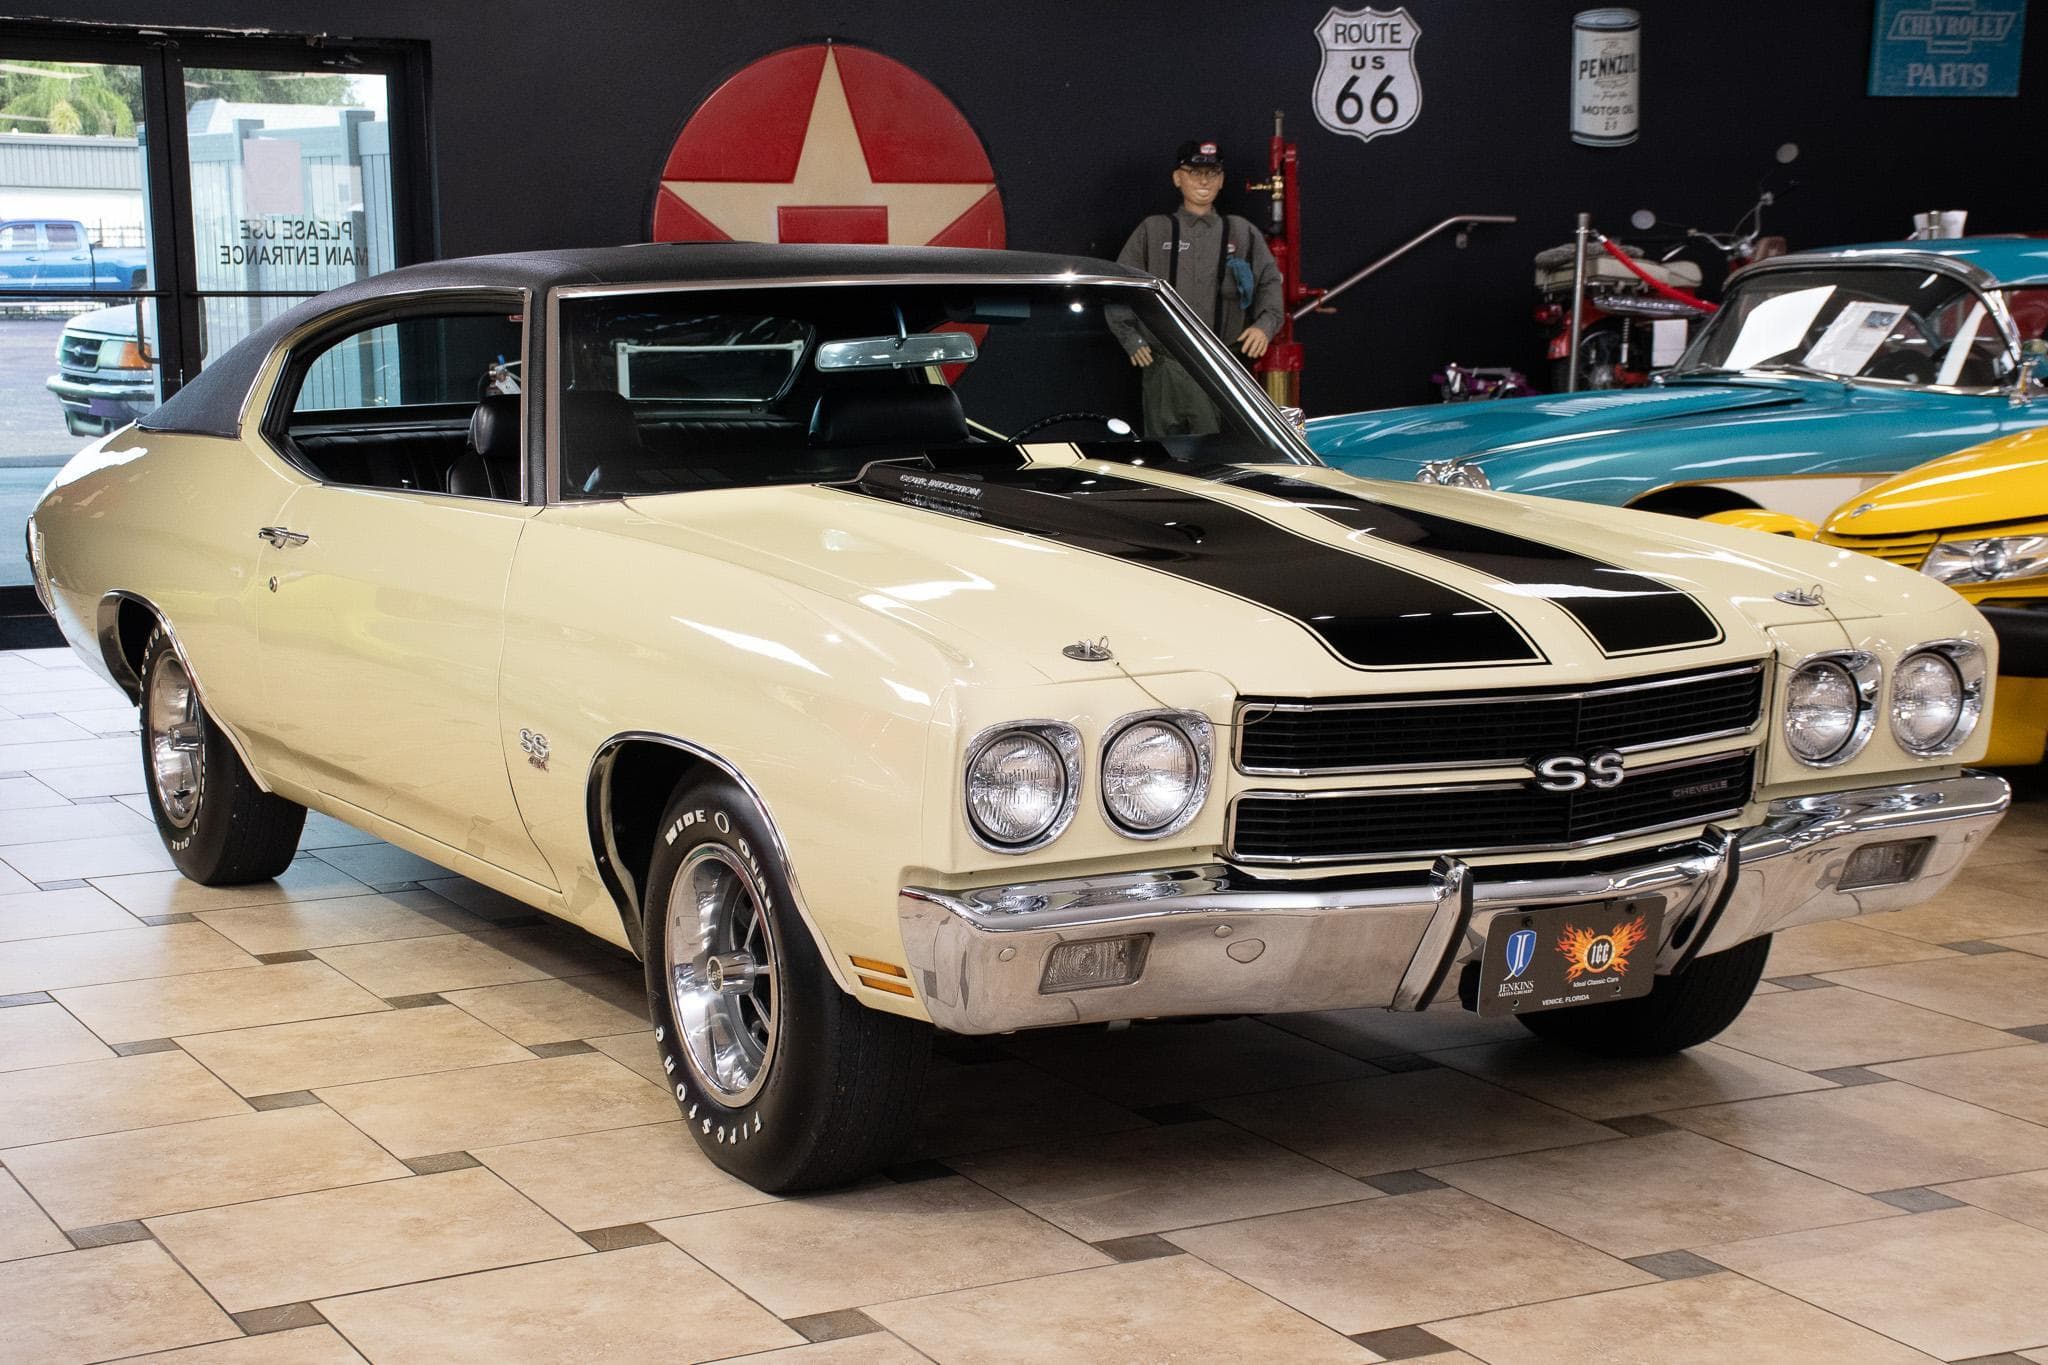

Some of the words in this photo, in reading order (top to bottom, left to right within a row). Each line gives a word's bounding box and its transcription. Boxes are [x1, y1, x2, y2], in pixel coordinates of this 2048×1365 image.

[1334, 23, 1402, 44] ROUTE
[1898, 15, 2006, 36] CHEVROLET
[1351, 56, 1385, 70] US
[1906, 63, 1990, 87] PARTS
[1335, 74, 1399, 125] 66
[1581, 105, 1620, 116] MOTOR
[1622, 104, 1635, 115] OIL
[927, 479, 982, 496] INDUCTION
[520, 728, 549, 759] SS
[1537, 751, 1625, 792] SS
[1672, 780, 1729, 798] CHEVELLE
[664, 808, 707, 848] WIDE
[738, 838, 773, 917] OVAL
[1498, 981, 1535, 993] JENKINS
[1587, 978, 1606, 986] Classic
[1565, 994, 1590, 1003] FLORIDA
